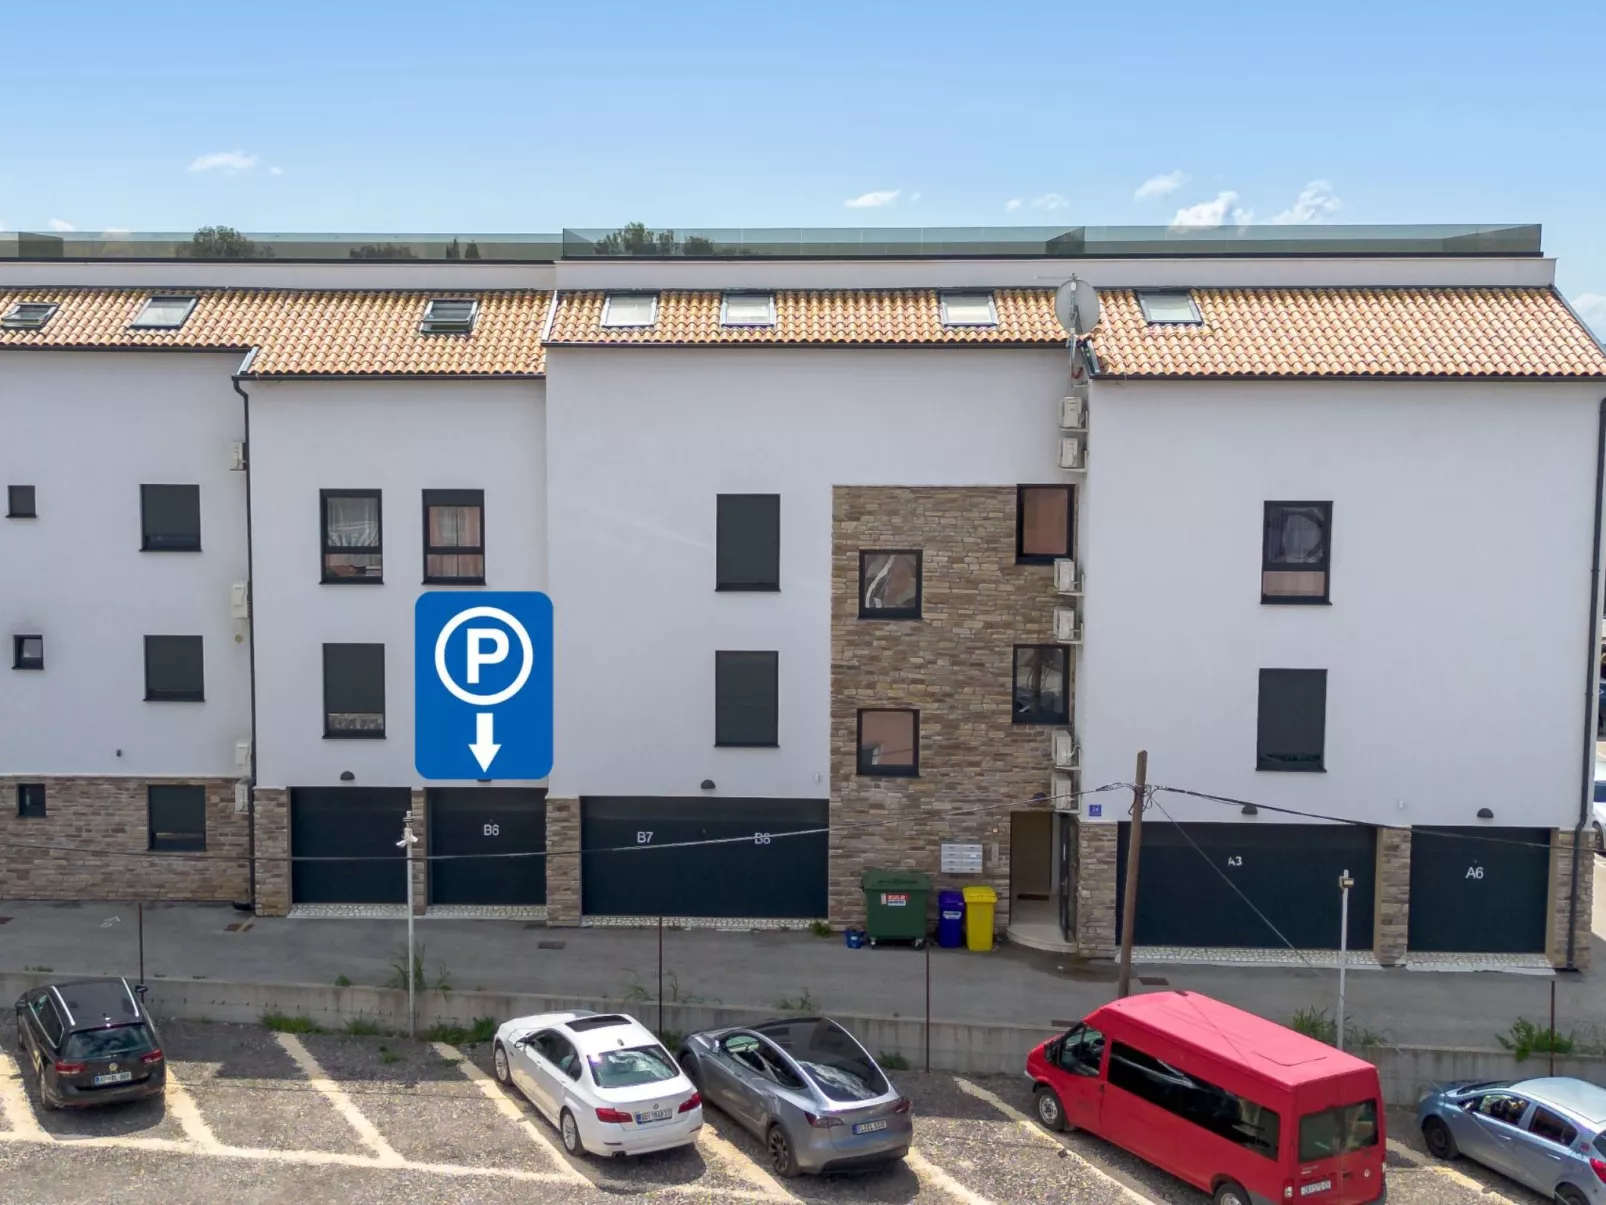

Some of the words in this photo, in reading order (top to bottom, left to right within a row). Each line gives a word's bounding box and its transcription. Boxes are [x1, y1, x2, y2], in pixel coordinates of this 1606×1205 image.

[484, 824, 500, 836] B6
[637, 831, 654, 843] B7
[1228, 856, 1243, 866] A3
[1465, 866, 1484, 879] A6
